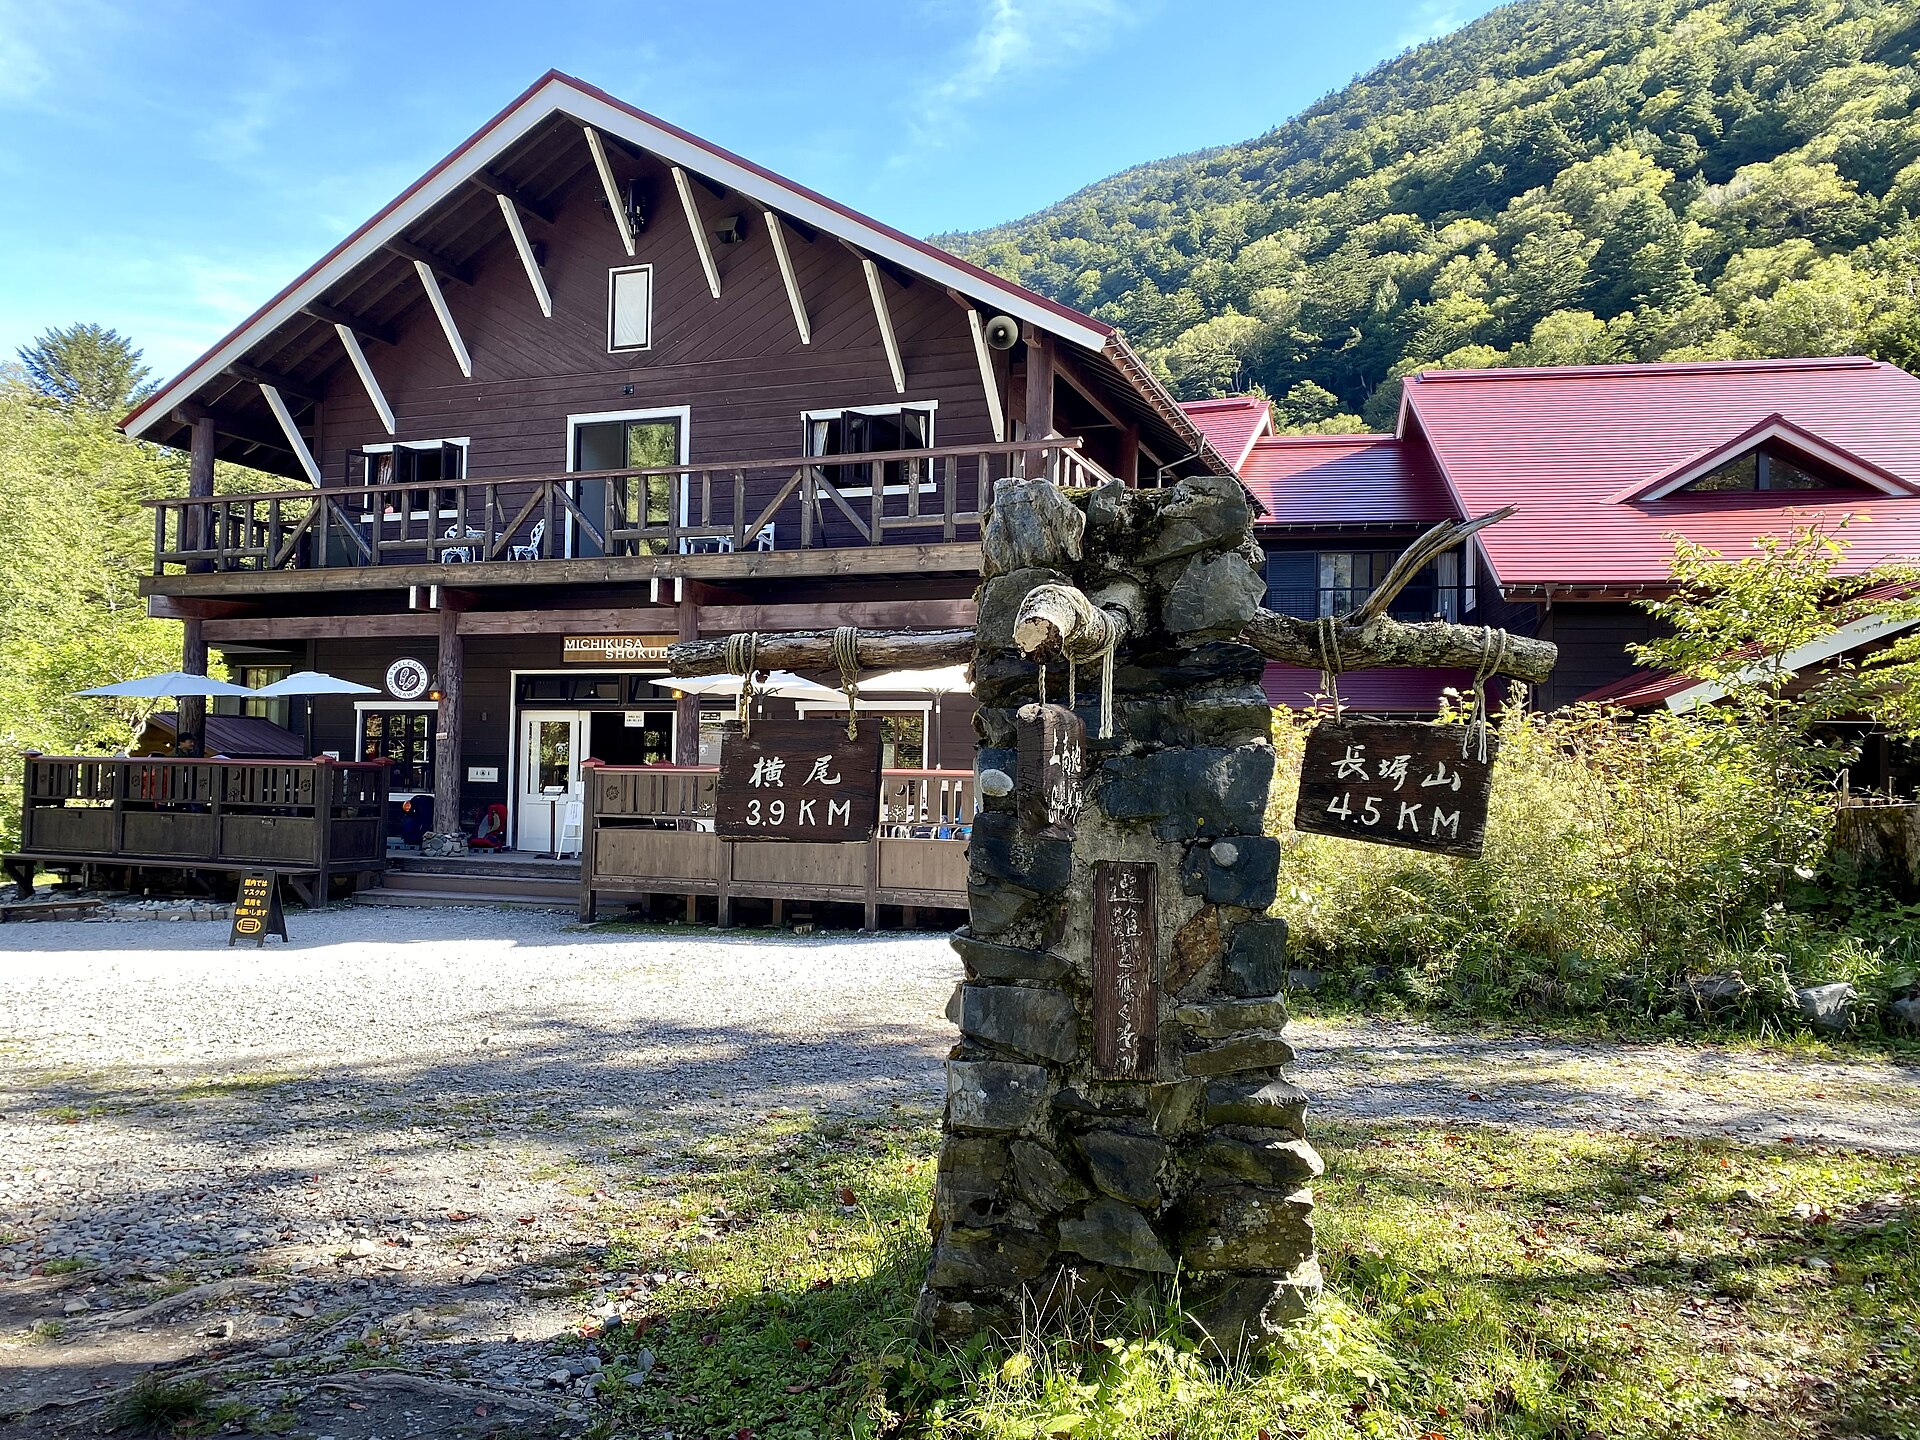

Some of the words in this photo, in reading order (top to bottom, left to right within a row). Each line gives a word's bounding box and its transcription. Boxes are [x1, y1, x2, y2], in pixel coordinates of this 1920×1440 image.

[564, 639, 644, 649] MICHIKUSA
[392, 661, 425, 676] WELCOME
[388, 676, 419, 697] TOKUSAWA
[748, 754, 842, 788] 横尾
[745, 799, 785, 827] 3.9
[1326, 792, 1383, 826] 4.5
[235, 908, 267, 916] お願いします
